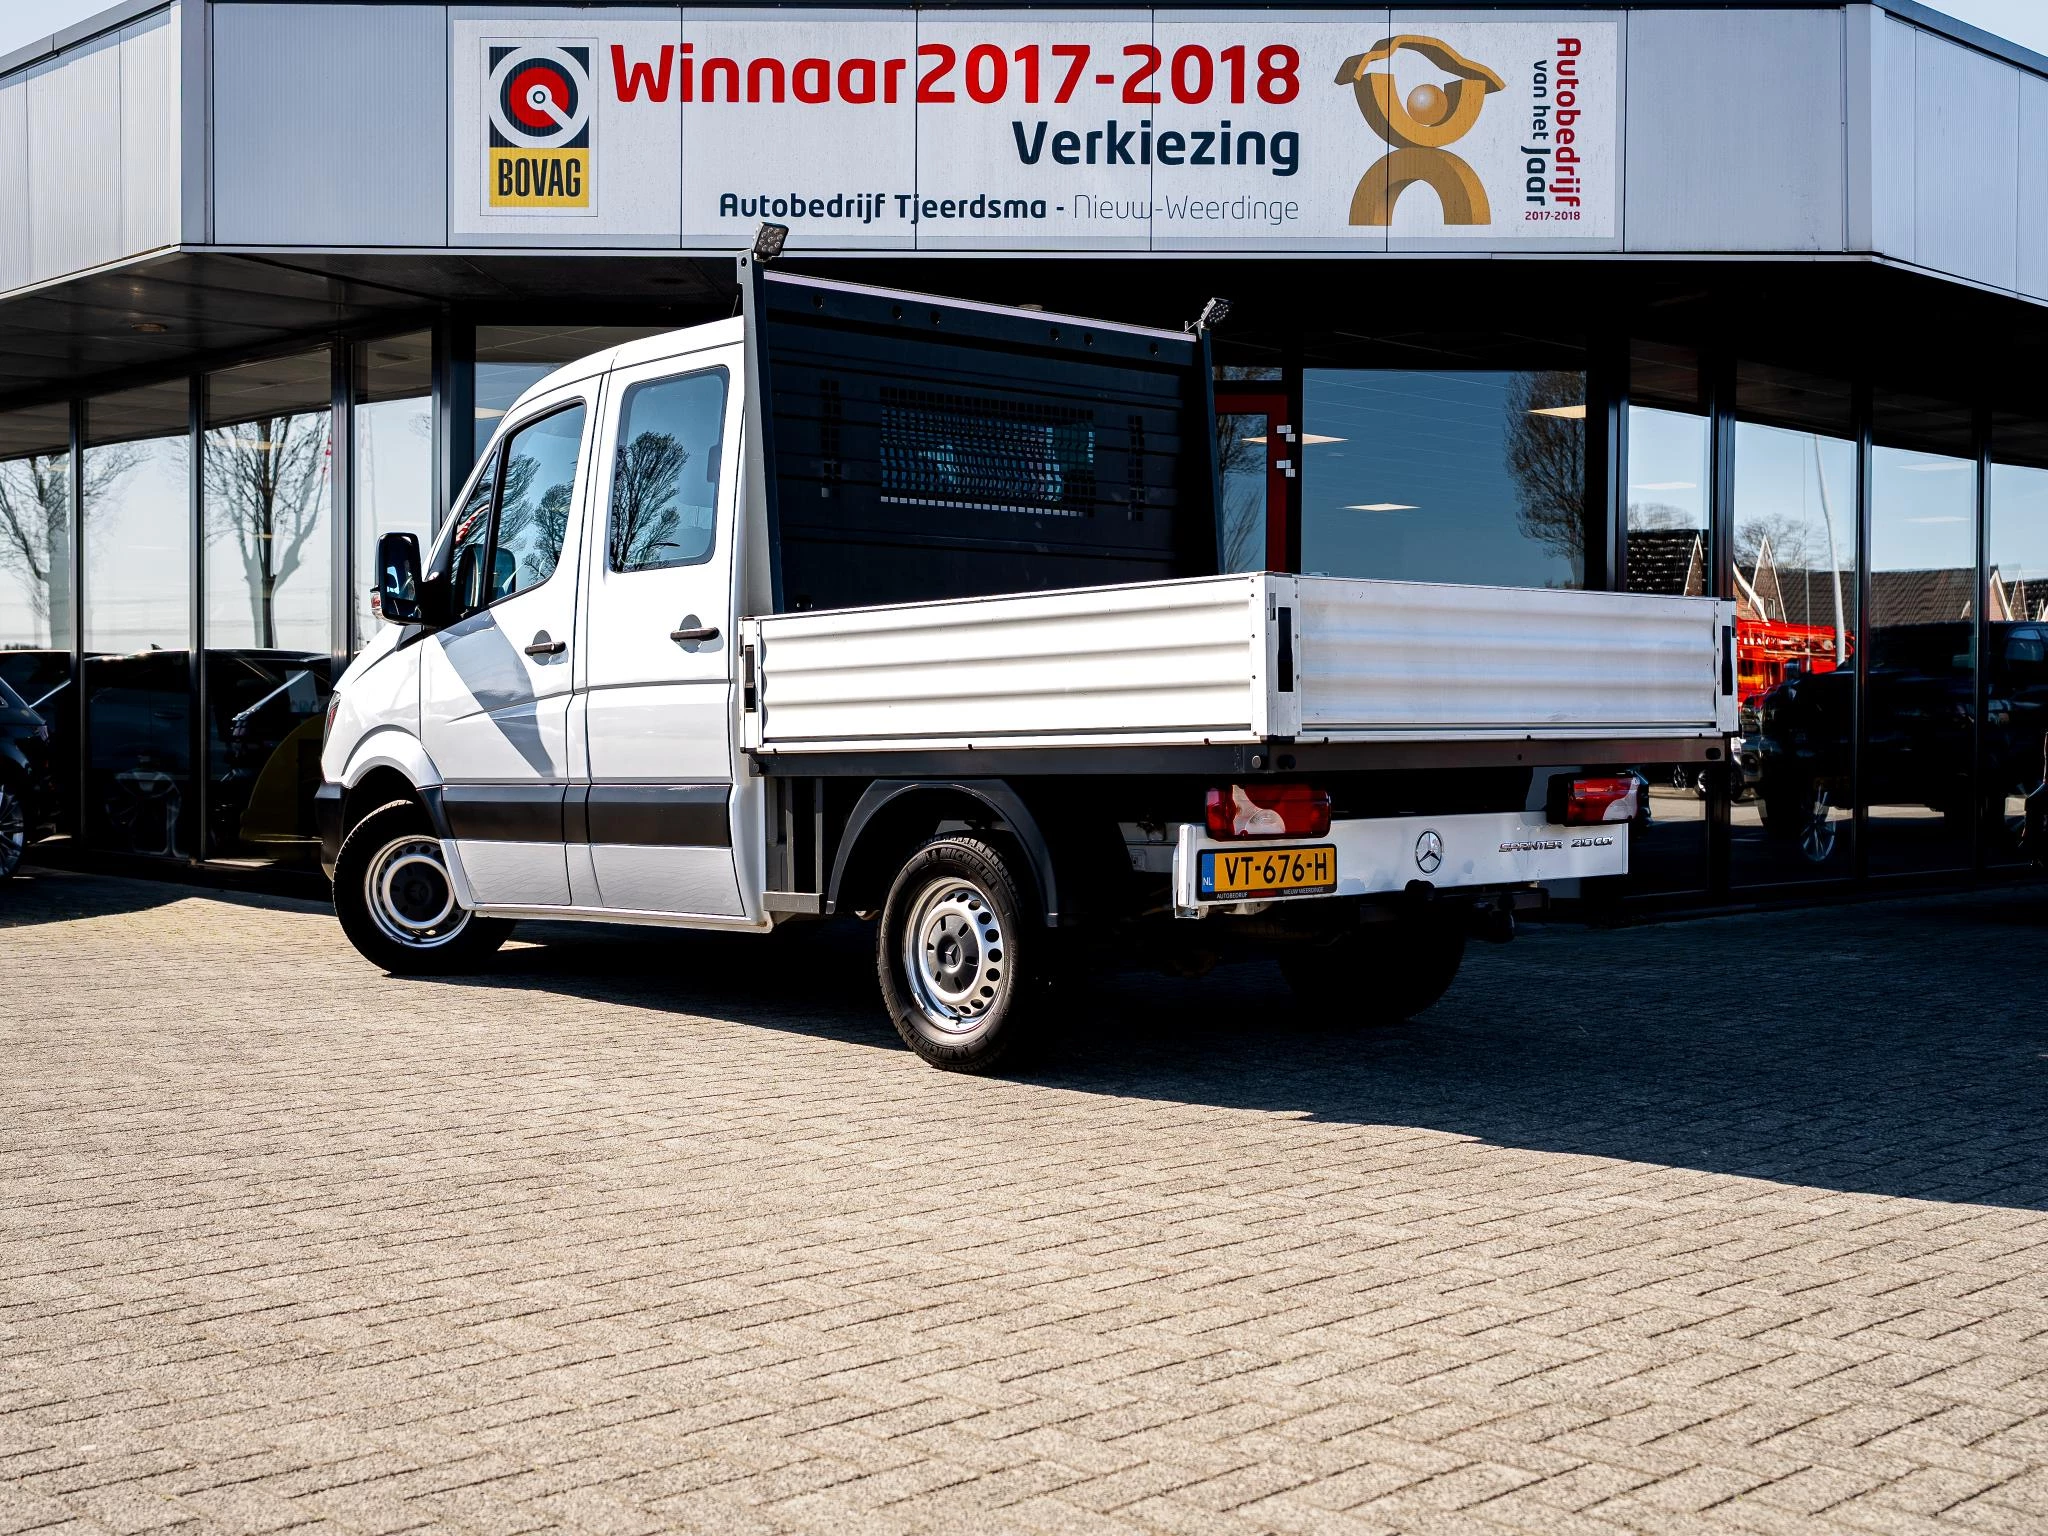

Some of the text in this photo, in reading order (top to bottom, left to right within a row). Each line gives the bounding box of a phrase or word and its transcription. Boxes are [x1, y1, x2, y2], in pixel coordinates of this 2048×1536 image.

[610, 44, 1300, 104] Winnaar 2017-2018
[1520, 59, 1551, 207] van het Jaar
[1549, 38, 1582, 207] Autobedrijf
[1012, 120, 1300, 177] Verkiezing
[497, 157, 582, 197] BOVAG
[719, 193, 886, 223] Autobedrijf
[893, 193, 1048, 223] Tjeerdsma
[1072, 194, 1300, 226] Nieuw-Weerdinge
[1524, 211, 1581, 221] 2017-2018
[1203, 877, 1212, 886] NL
[1225, 852, 1327, 886] VT-676-H
